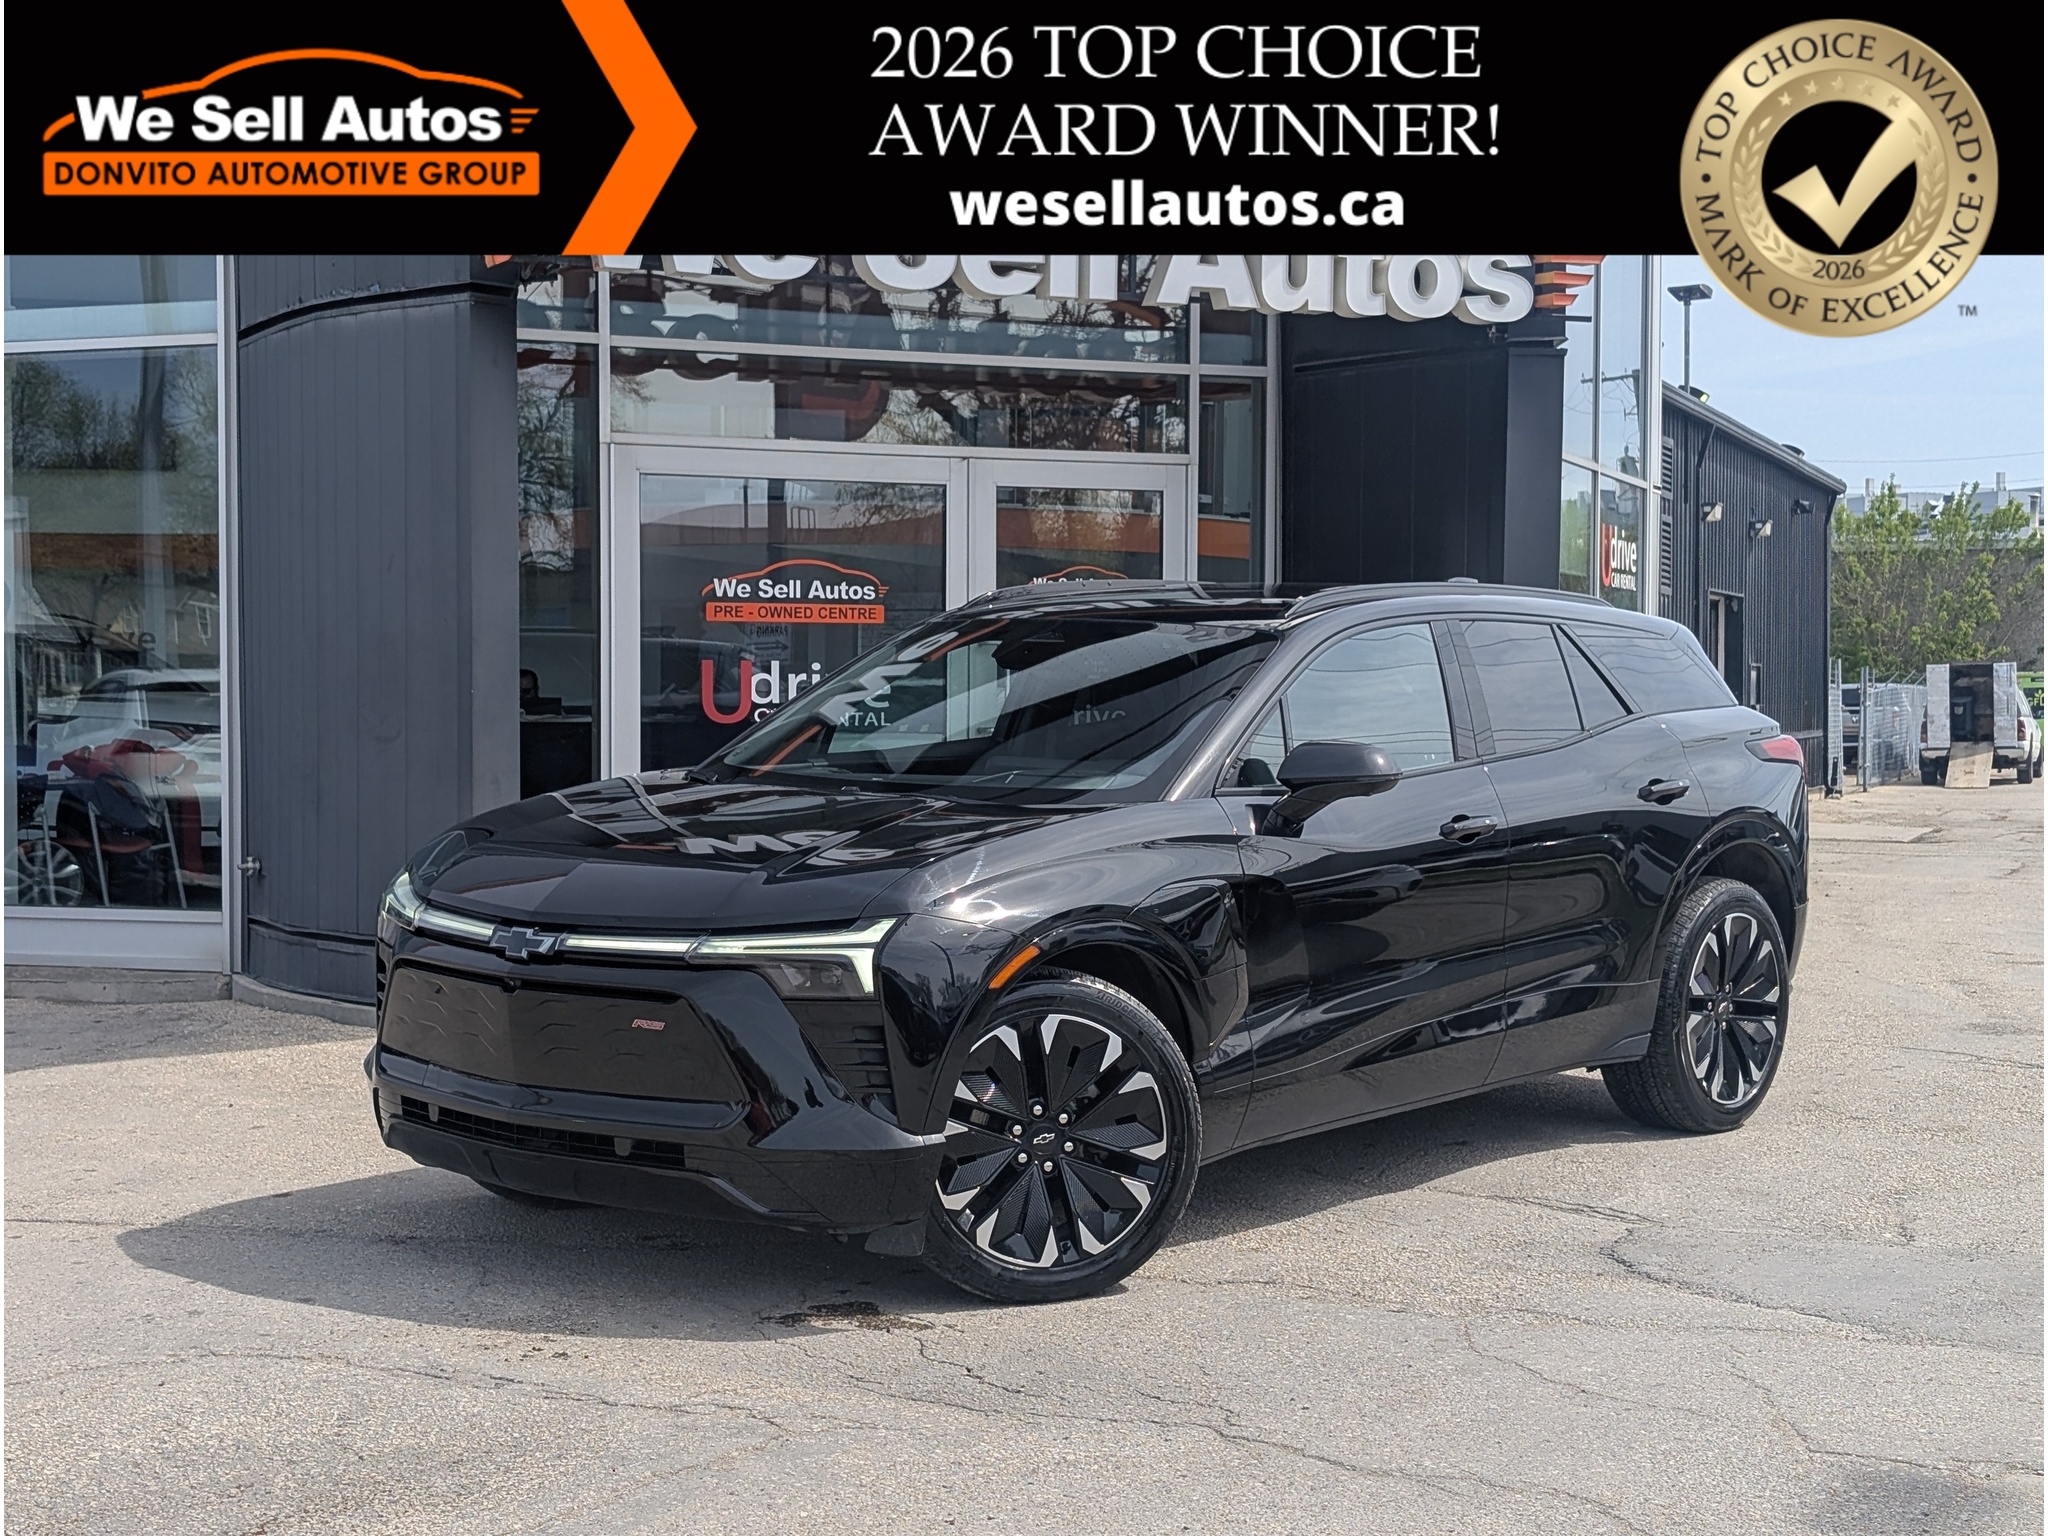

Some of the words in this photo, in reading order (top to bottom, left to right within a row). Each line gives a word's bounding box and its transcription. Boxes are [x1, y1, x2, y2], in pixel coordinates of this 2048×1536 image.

[1157, 255, 1534, 323] Autos
[1602, 523, 1637, 587] Udrive
[713, 578, 751, 598] We
[758, 579, 801, 599] Sell
[808, 580, 876, 600] Autos
[1611, 571, 1620, 588] CAR
[1621, 573, 1637, 591] RENTAL
[713, 605, 744, 618] PRE
[757, 606, 813, 619] OWNED
[818, 607, 877, 620] CENTRE
